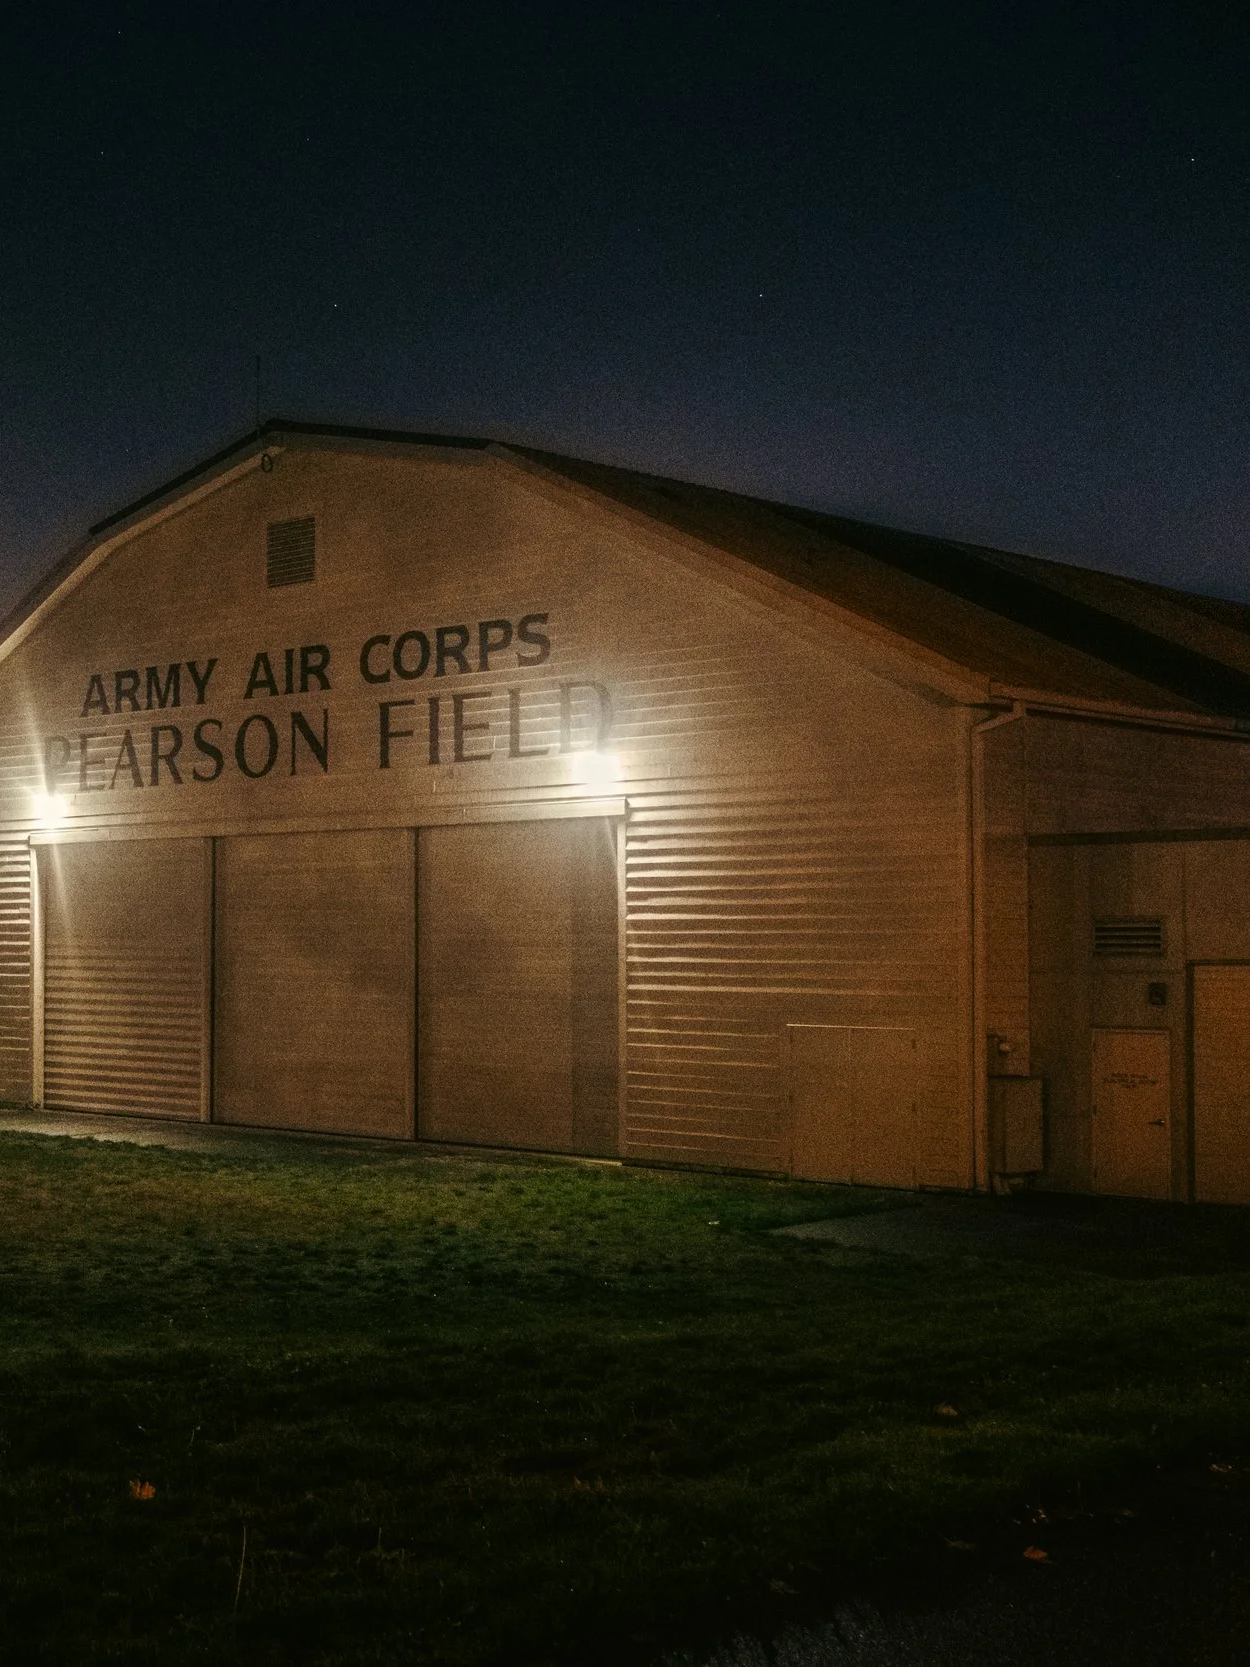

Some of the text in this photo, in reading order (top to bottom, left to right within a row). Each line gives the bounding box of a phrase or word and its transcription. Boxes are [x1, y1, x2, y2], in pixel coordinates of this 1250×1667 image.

[80, 612, 550, 718] ARMY AIR CORPS
[44, 680, 616, 793] PEARSON FIELD
